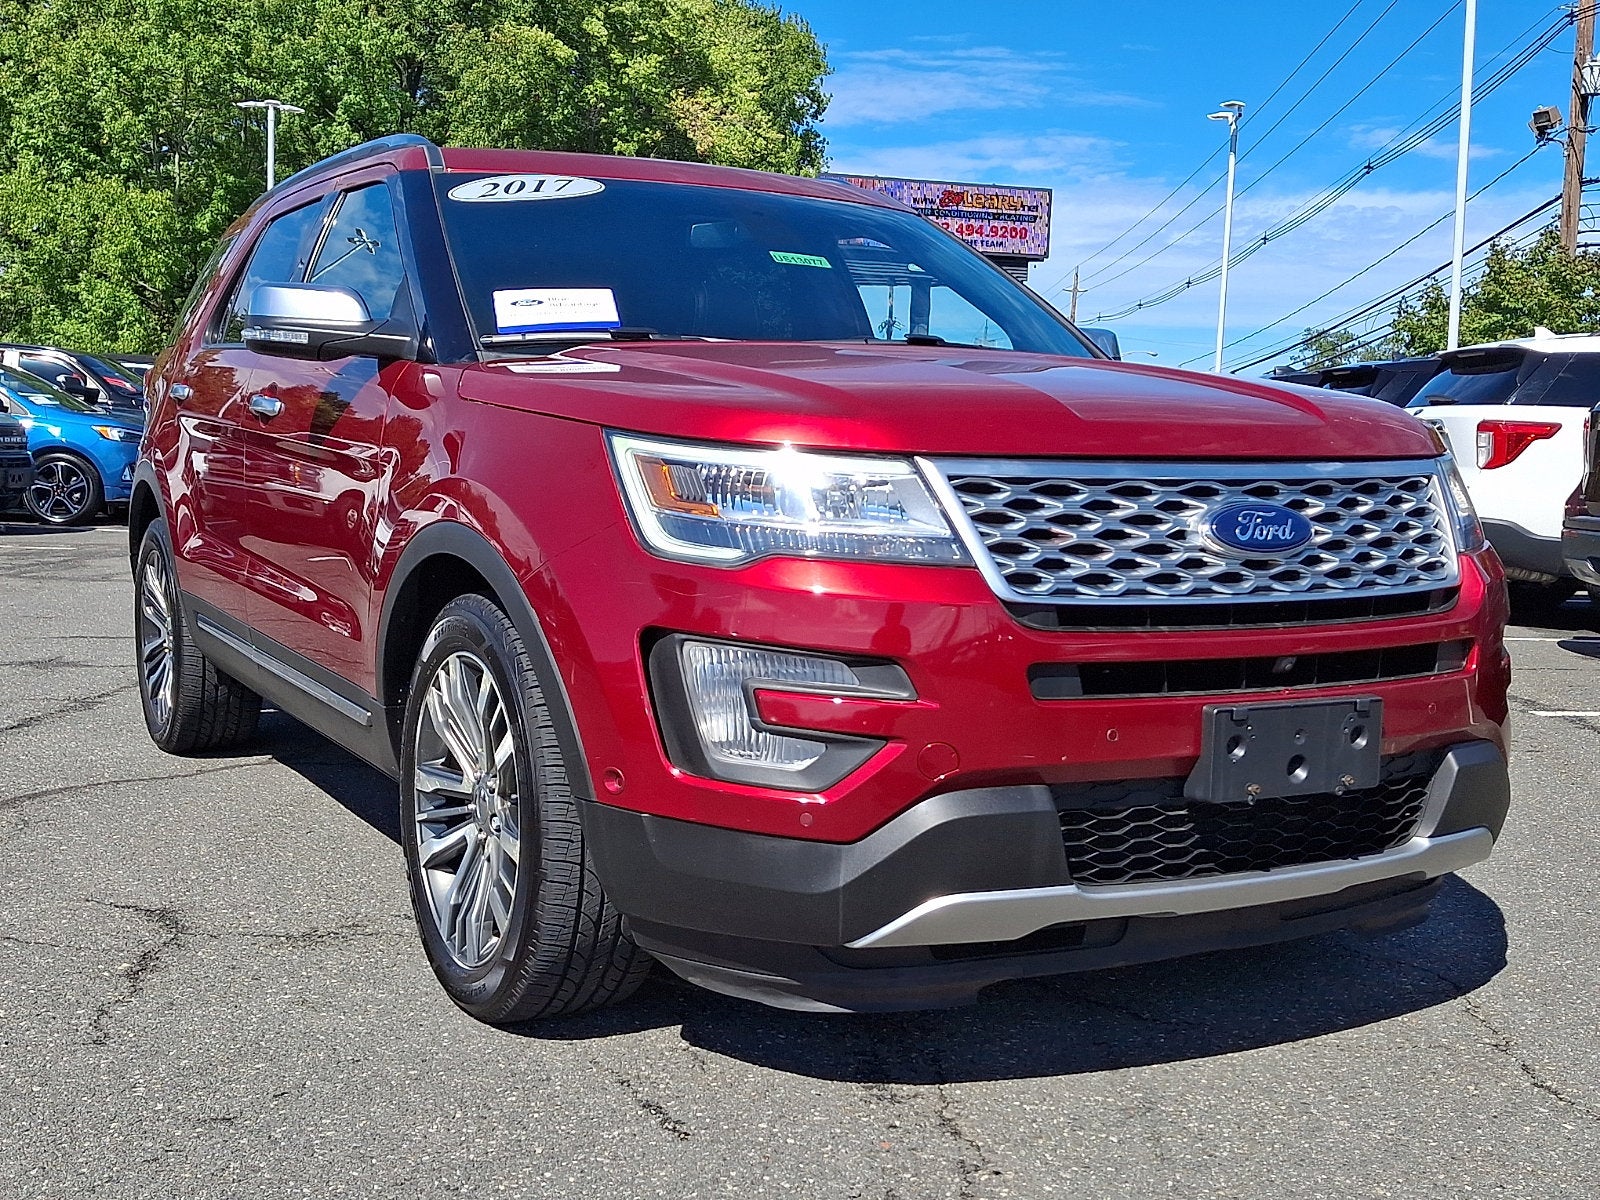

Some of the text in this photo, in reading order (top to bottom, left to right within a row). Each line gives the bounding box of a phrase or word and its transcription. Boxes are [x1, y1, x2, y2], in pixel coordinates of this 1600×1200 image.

[477, 179, 575, 198] 2017
[934, 209, 993, 220] CONDITIONING
[1235, 510, 1295, 541] Ford
